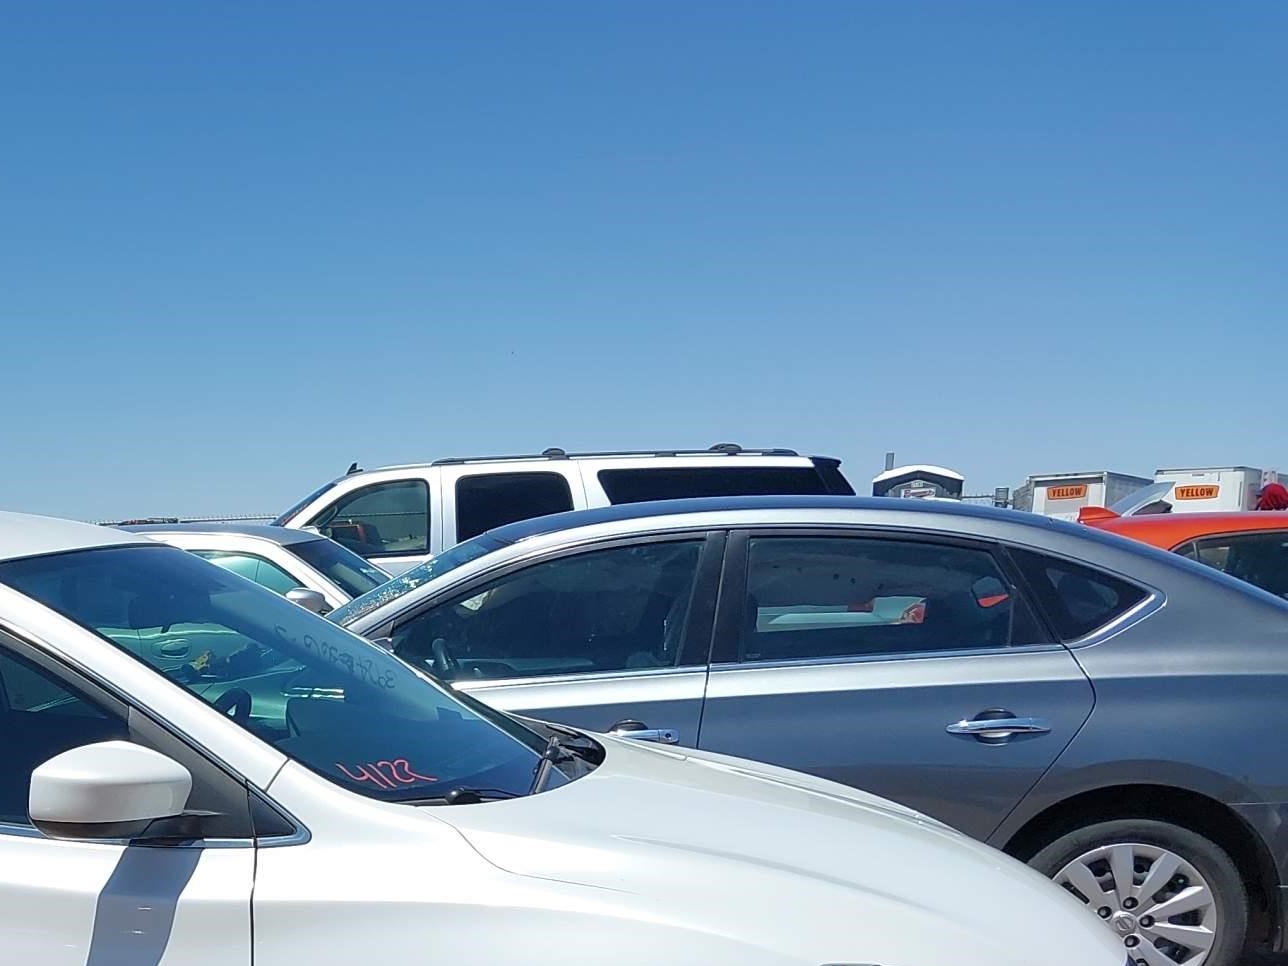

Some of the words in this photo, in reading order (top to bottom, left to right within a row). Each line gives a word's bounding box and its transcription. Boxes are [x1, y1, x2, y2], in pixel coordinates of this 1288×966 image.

[1051, 485, 1083, 497] YELLOW
[1179, 487, 1215, 497] YELLOW
[335, 759, 438, 789] 4122
